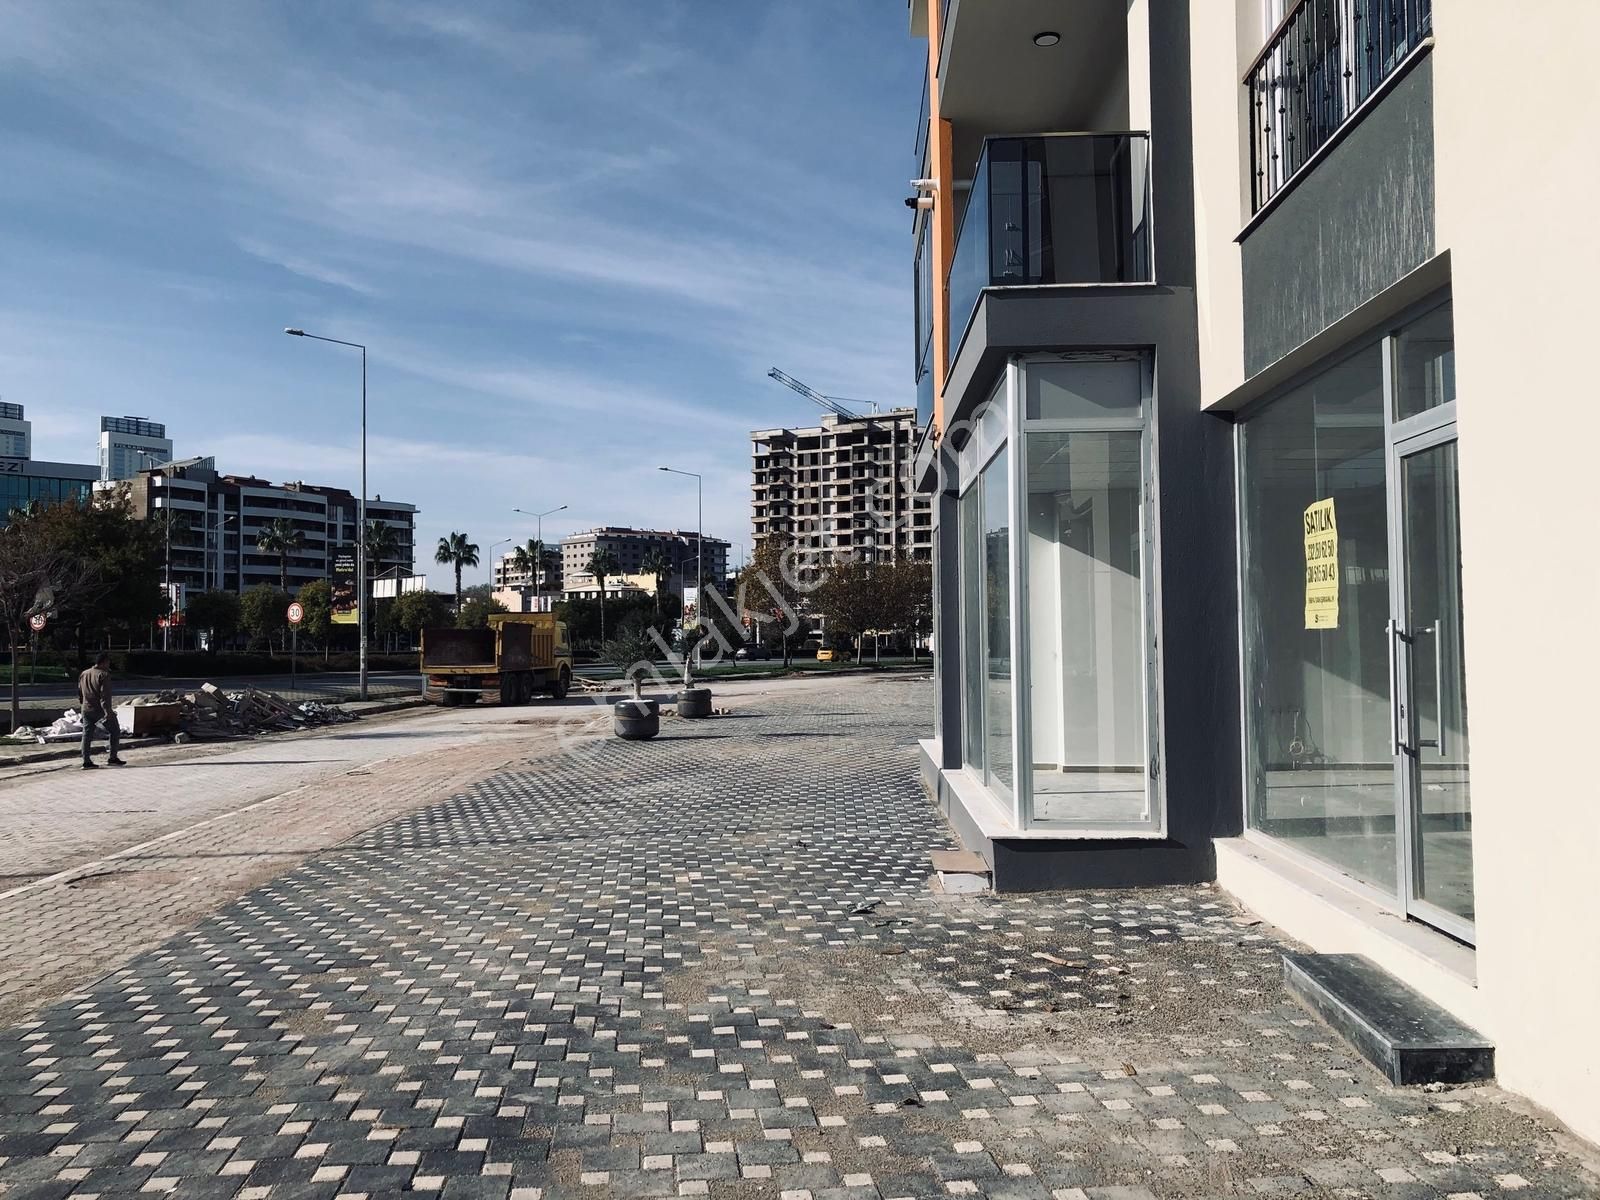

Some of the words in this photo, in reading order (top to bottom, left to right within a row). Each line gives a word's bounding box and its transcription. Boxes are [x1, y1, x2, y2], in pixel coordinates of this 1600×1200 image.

[1305, 507, 1333, 535] SATILIK
[1329, 563, 1335, 580] 43
[291, 609, 299, 617] 30
